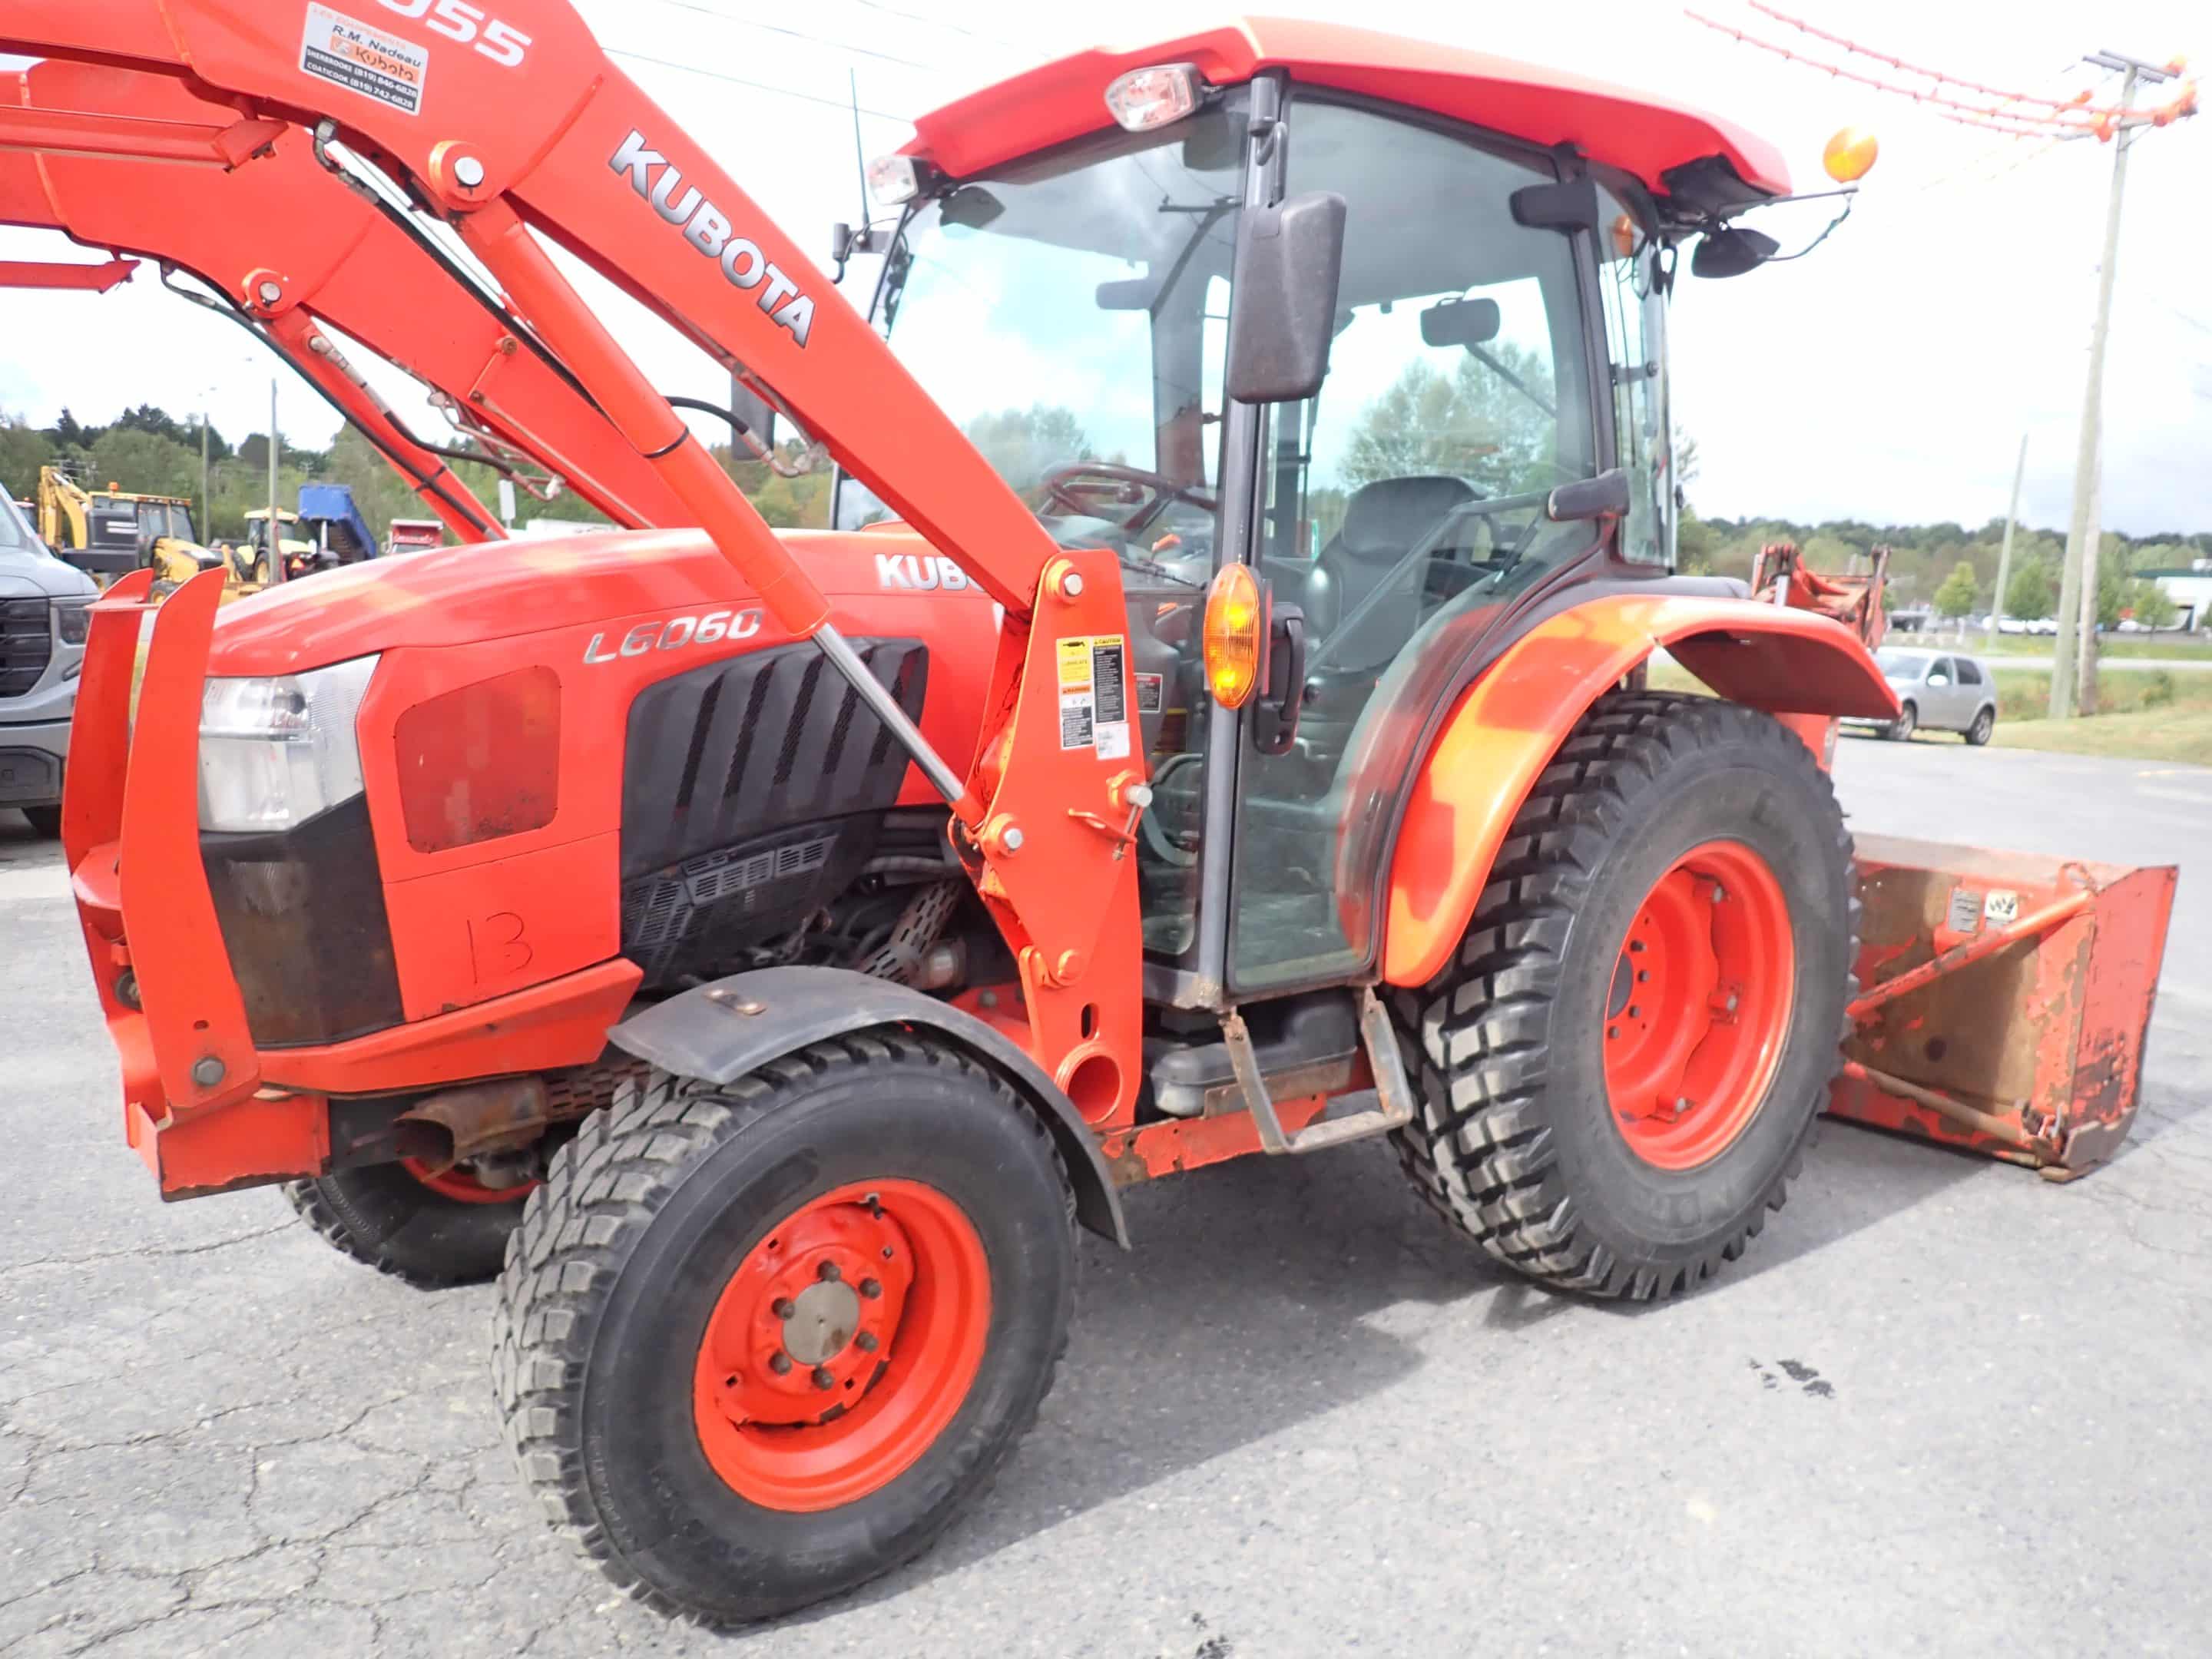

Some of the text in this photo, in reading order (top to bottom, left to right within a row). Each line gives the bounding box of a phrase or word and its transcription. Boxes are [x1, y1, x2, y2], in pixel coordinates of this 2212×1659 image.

[332, 25, 363, 45] R.M.
[369, 39, 421, 68] Nadeau
[356, 46, 414, 81] Kubota
[349, 78, 373, 93] (819)
[354, 68, 376, 82] (819)
[608, 127, 816, 349] KUBOTA
[874, 553, 986, 593] KUB
[583, 608, 764, 664] L6060
